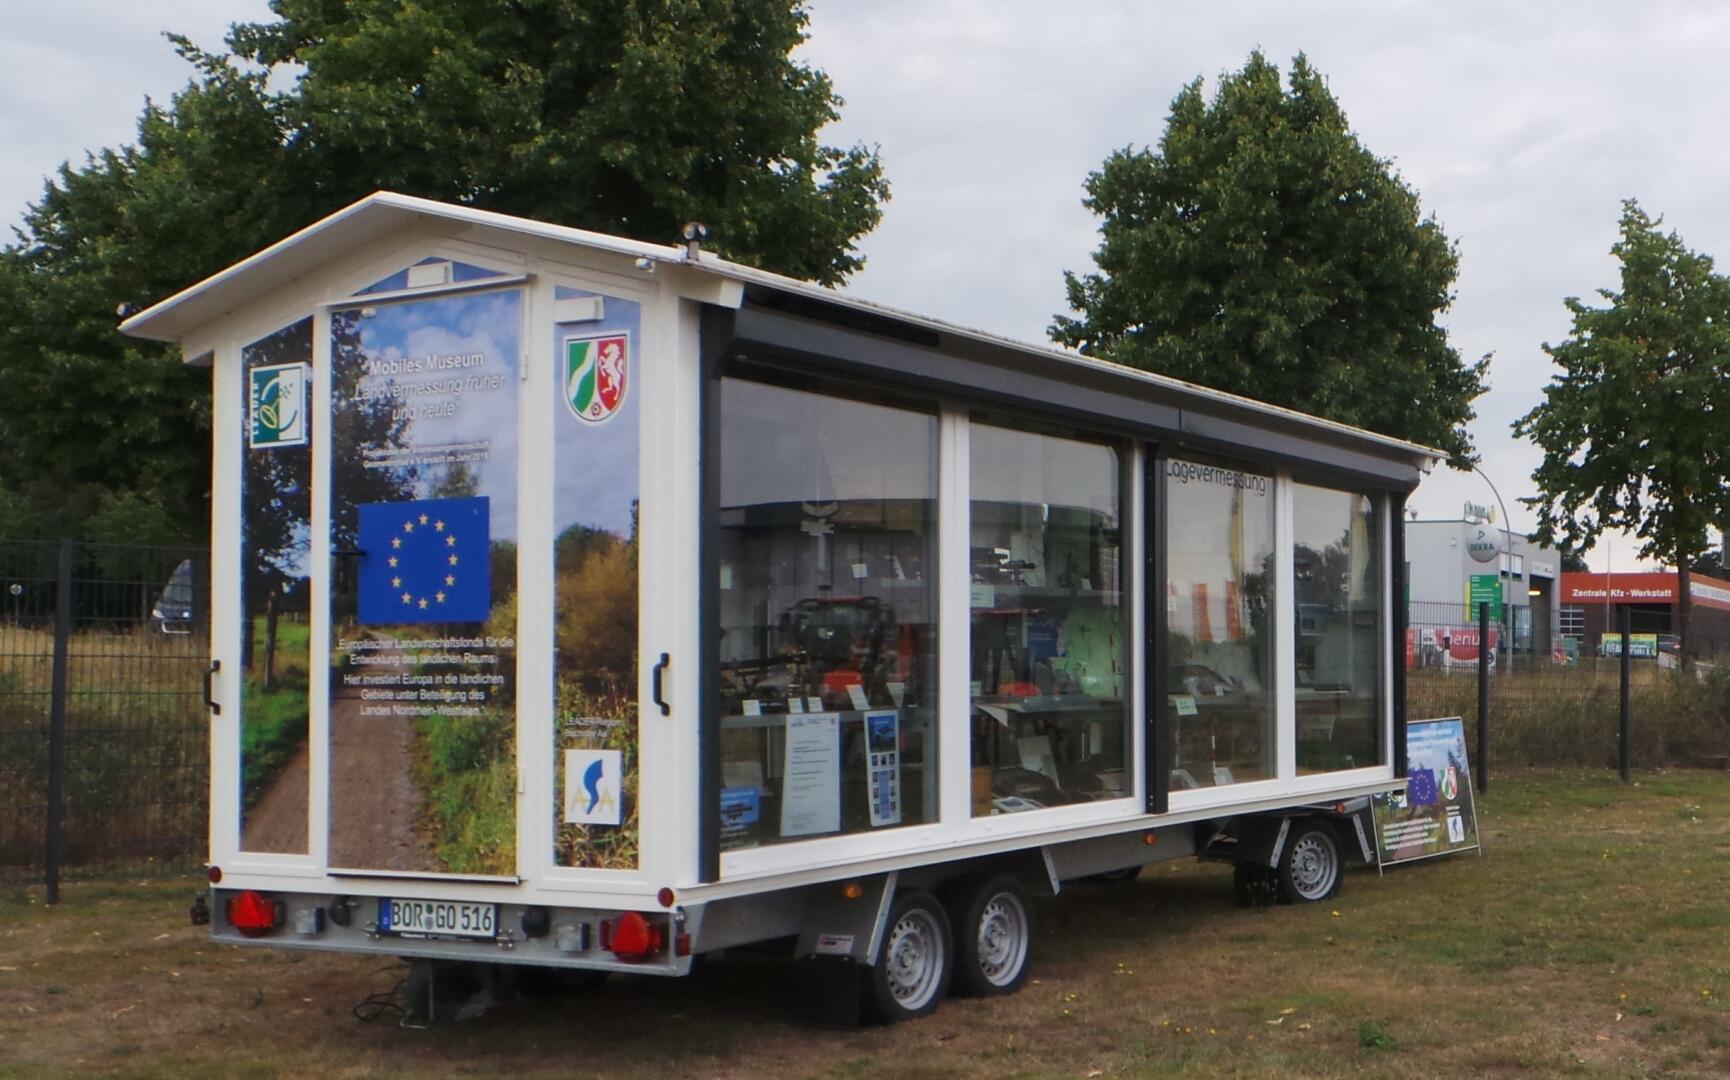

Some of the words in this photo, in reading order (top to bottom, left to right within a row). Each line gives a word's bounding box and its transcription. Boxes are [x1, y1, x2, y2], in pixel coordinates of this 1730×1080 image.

[370, 358, 422, 376] Mobiles
[426, 353, 484, 370] Museum
[392, 404, 416, 421] und
[1469, 543, 1495, 552] DEKRA
[1572, 588, 1607, 598] Zentrale
[1610, 588, 1625, 598] Kfz
[1630, 588, 1672, 598] Werkstatt
[350, 653, 399, 667] Entwicklung
[343, 674, 361, 685] Hier
[362, 674, 400, 685] investiert
[402, 673, 433, 686] Europa
[434, 673, 443, 684] in
[444, 673, 458, 684] die
[459, 673, 504, 685] ländlichen
[361, 689, 394, 700] Gebiete
[396, 690, 418, 700] unter
[420, 689, 467, 703] Beteiligung
[468, 689, 485, 700] des
[360, 705, 391, 716] Landes
[391, 902, 423, 928] BOR
[436, 904, 457, 930] GO
[461, 906, 492, 932] 516
